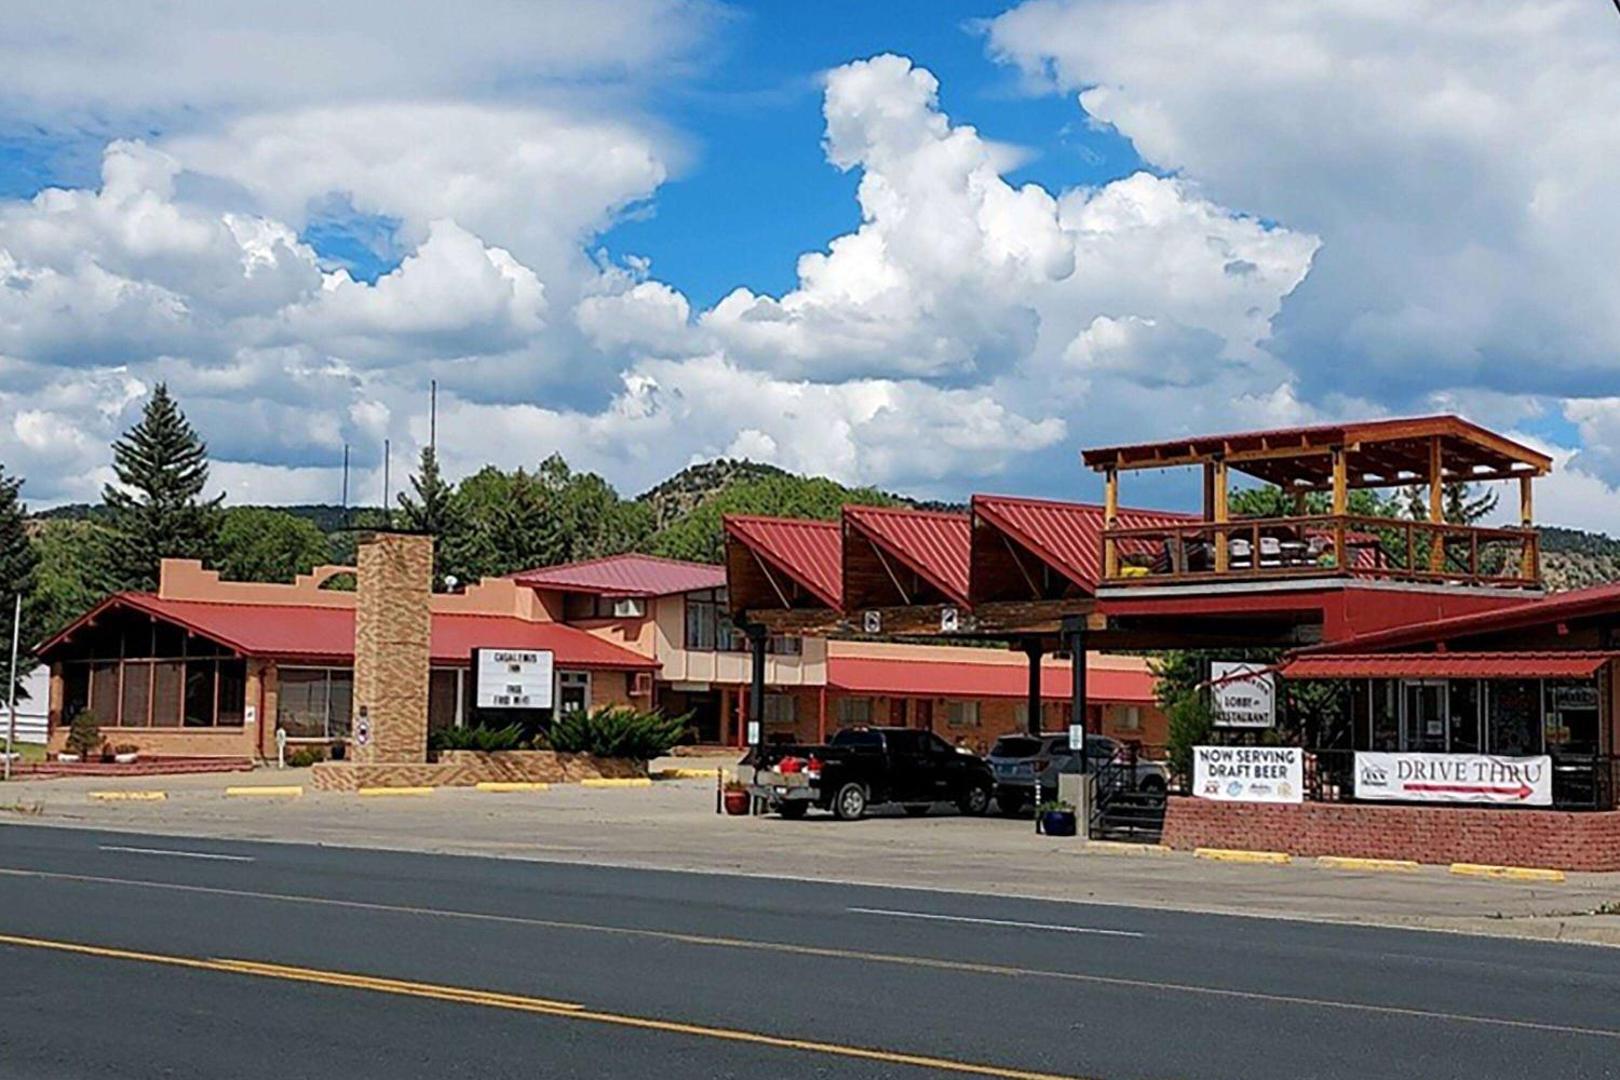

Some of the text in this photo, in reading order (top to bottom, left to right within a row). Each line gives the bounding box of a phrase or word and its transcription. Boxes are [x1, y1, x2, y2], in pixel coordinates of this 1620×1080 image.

[1224, 696, 1252, 708] LOBBY
[1200, 749, 1295, 764] NOW SERVING
[1208, 764, 1287, 779] DRAFT BEER
[1397, 760, 1543, 783] DRIVE THRU
